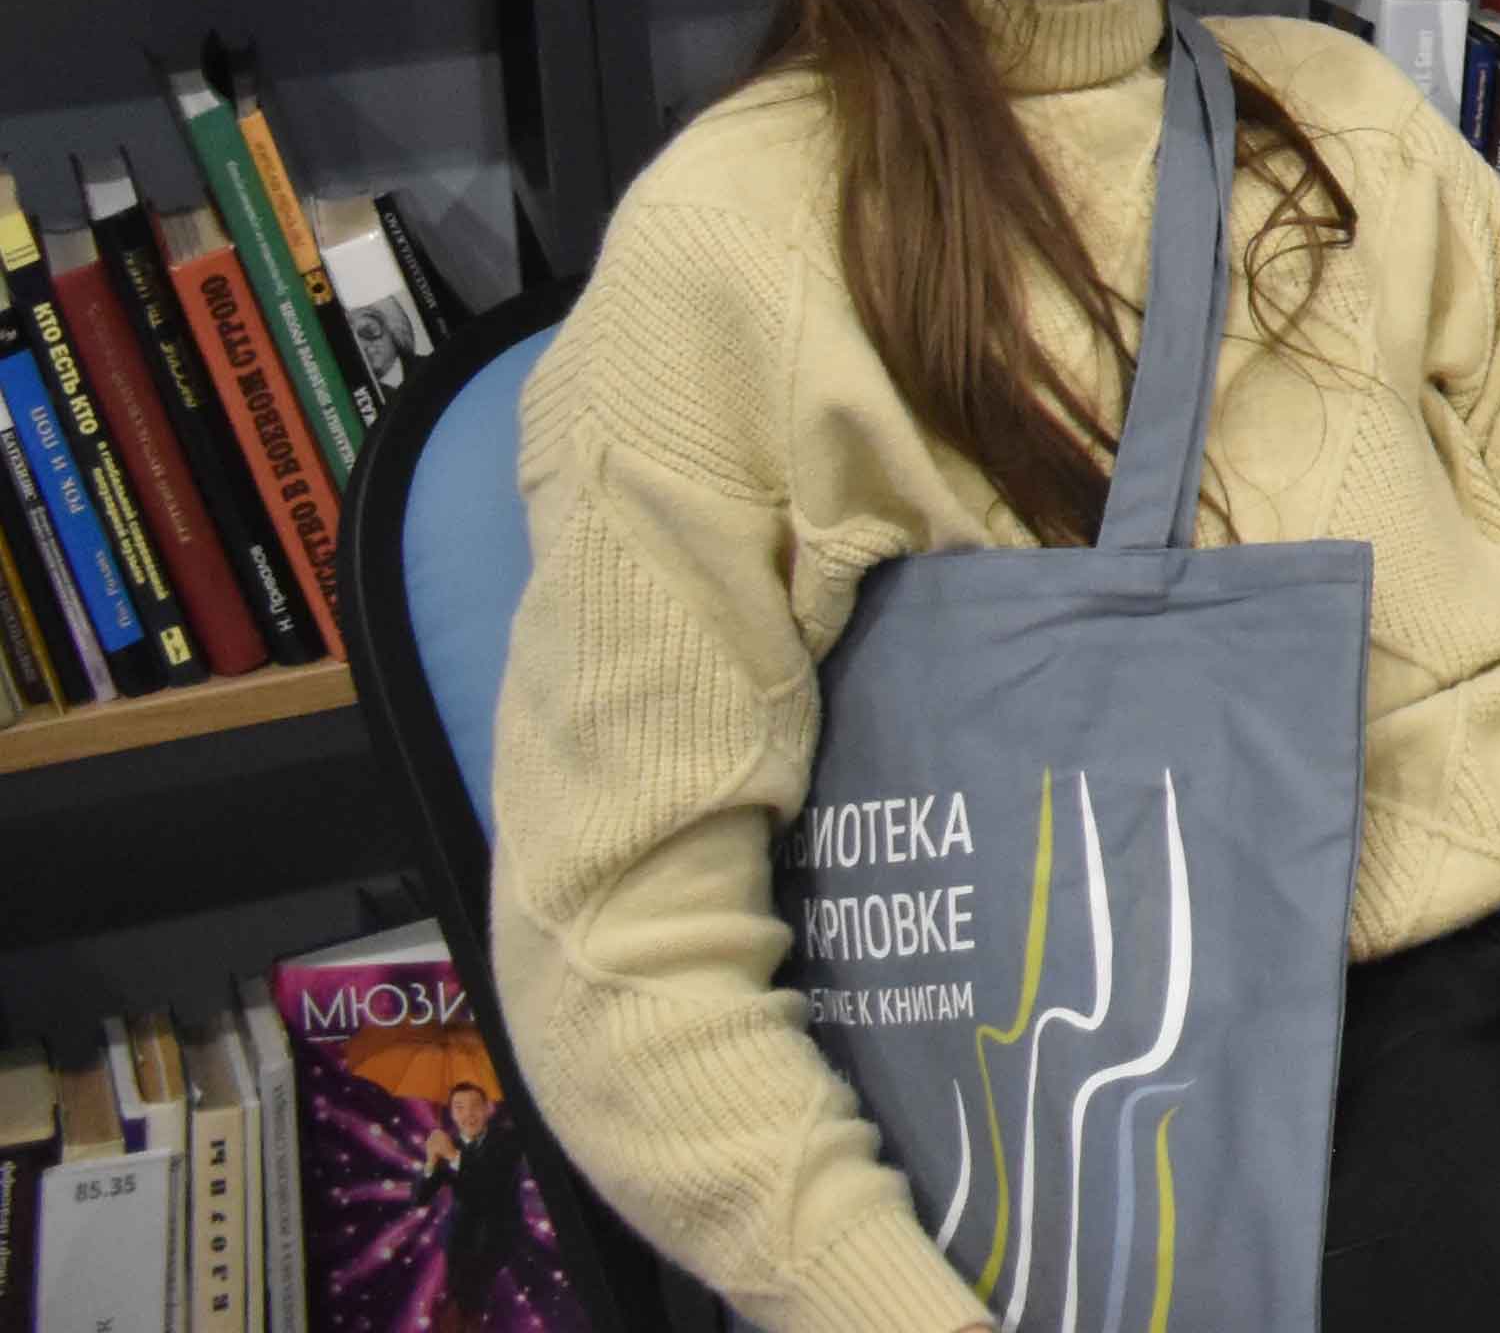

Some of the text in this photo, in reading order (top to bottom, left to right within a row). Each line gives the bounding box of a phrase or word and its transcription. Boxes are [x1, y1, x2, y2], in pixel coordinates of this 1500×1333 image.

[33, 301, 98, 436] КТО ЕСТЬ КТО
[798, 792, 974, 869] ИОТЕКА
[804, 885, 975, 961] КРПОВКЕ
[880, 982, 974, 1025] КНИГАМ
[75, 1175, 137, 1201] 85.35
